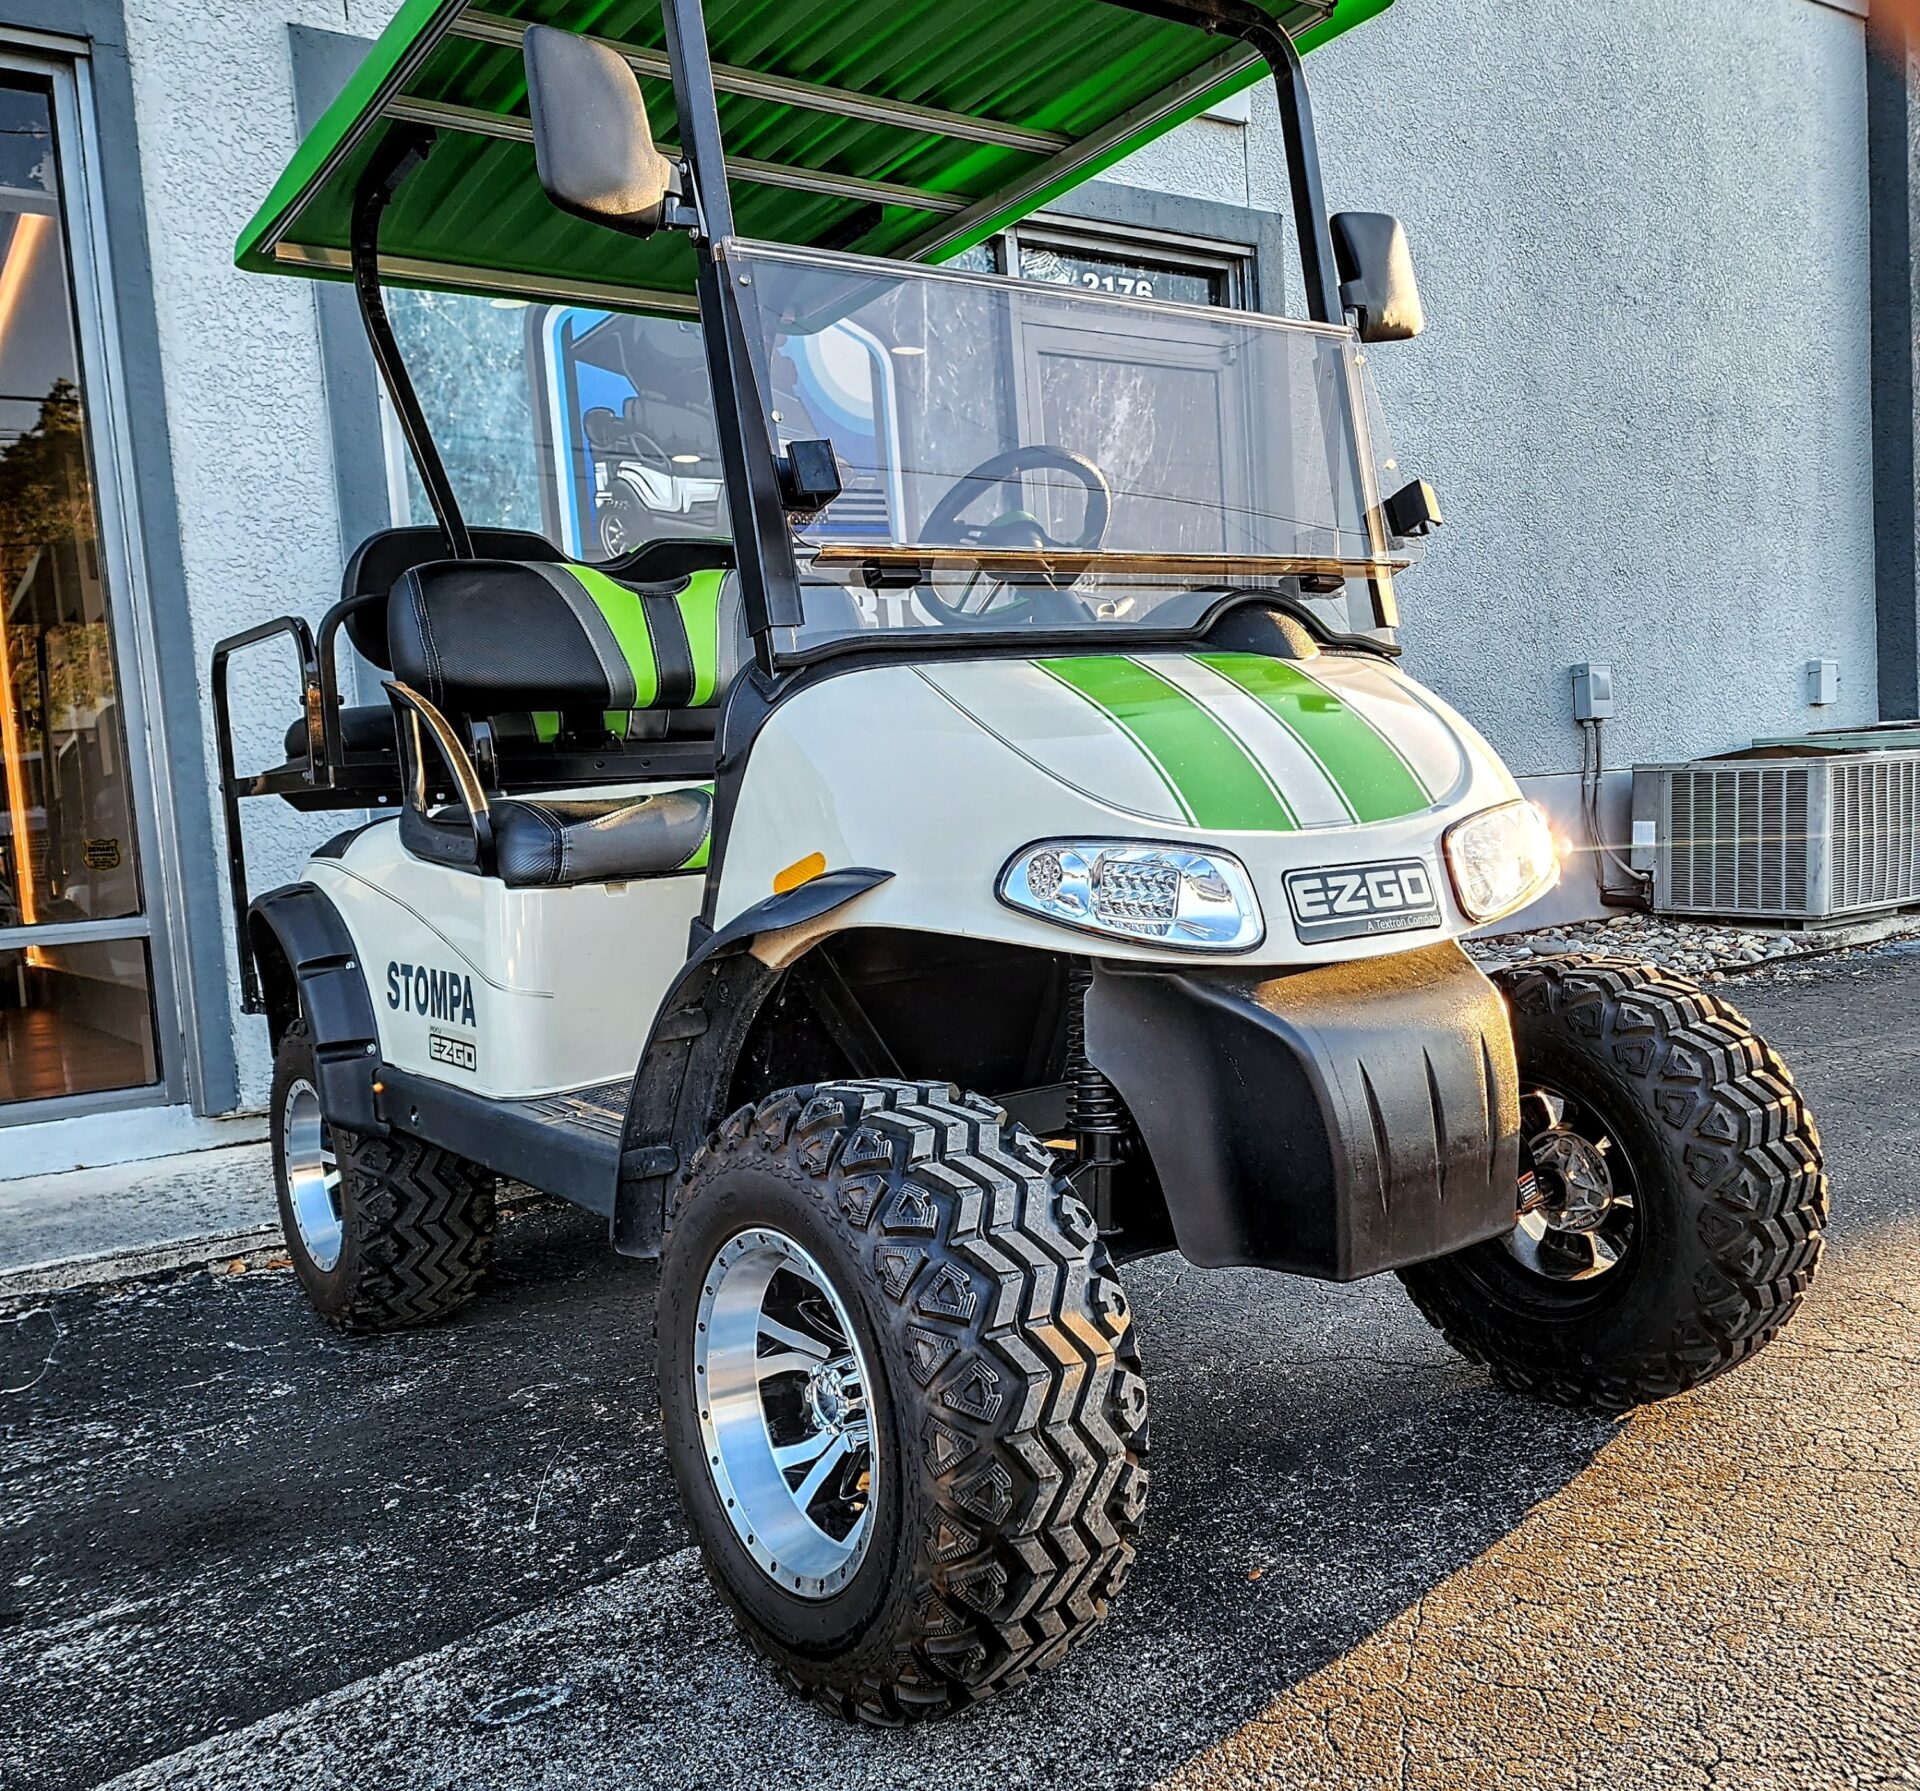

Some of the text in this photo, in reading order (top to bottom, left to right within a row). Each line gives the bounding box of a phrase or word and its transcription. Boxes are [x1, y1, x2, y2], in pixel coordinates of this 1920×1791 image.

[1082, 272, 1153, 298] 2176
[1367, 920, 1374, 931] A
[1375, 917, 1407, 930] Textron
[387, 960, 477, 1028] STOMPA
